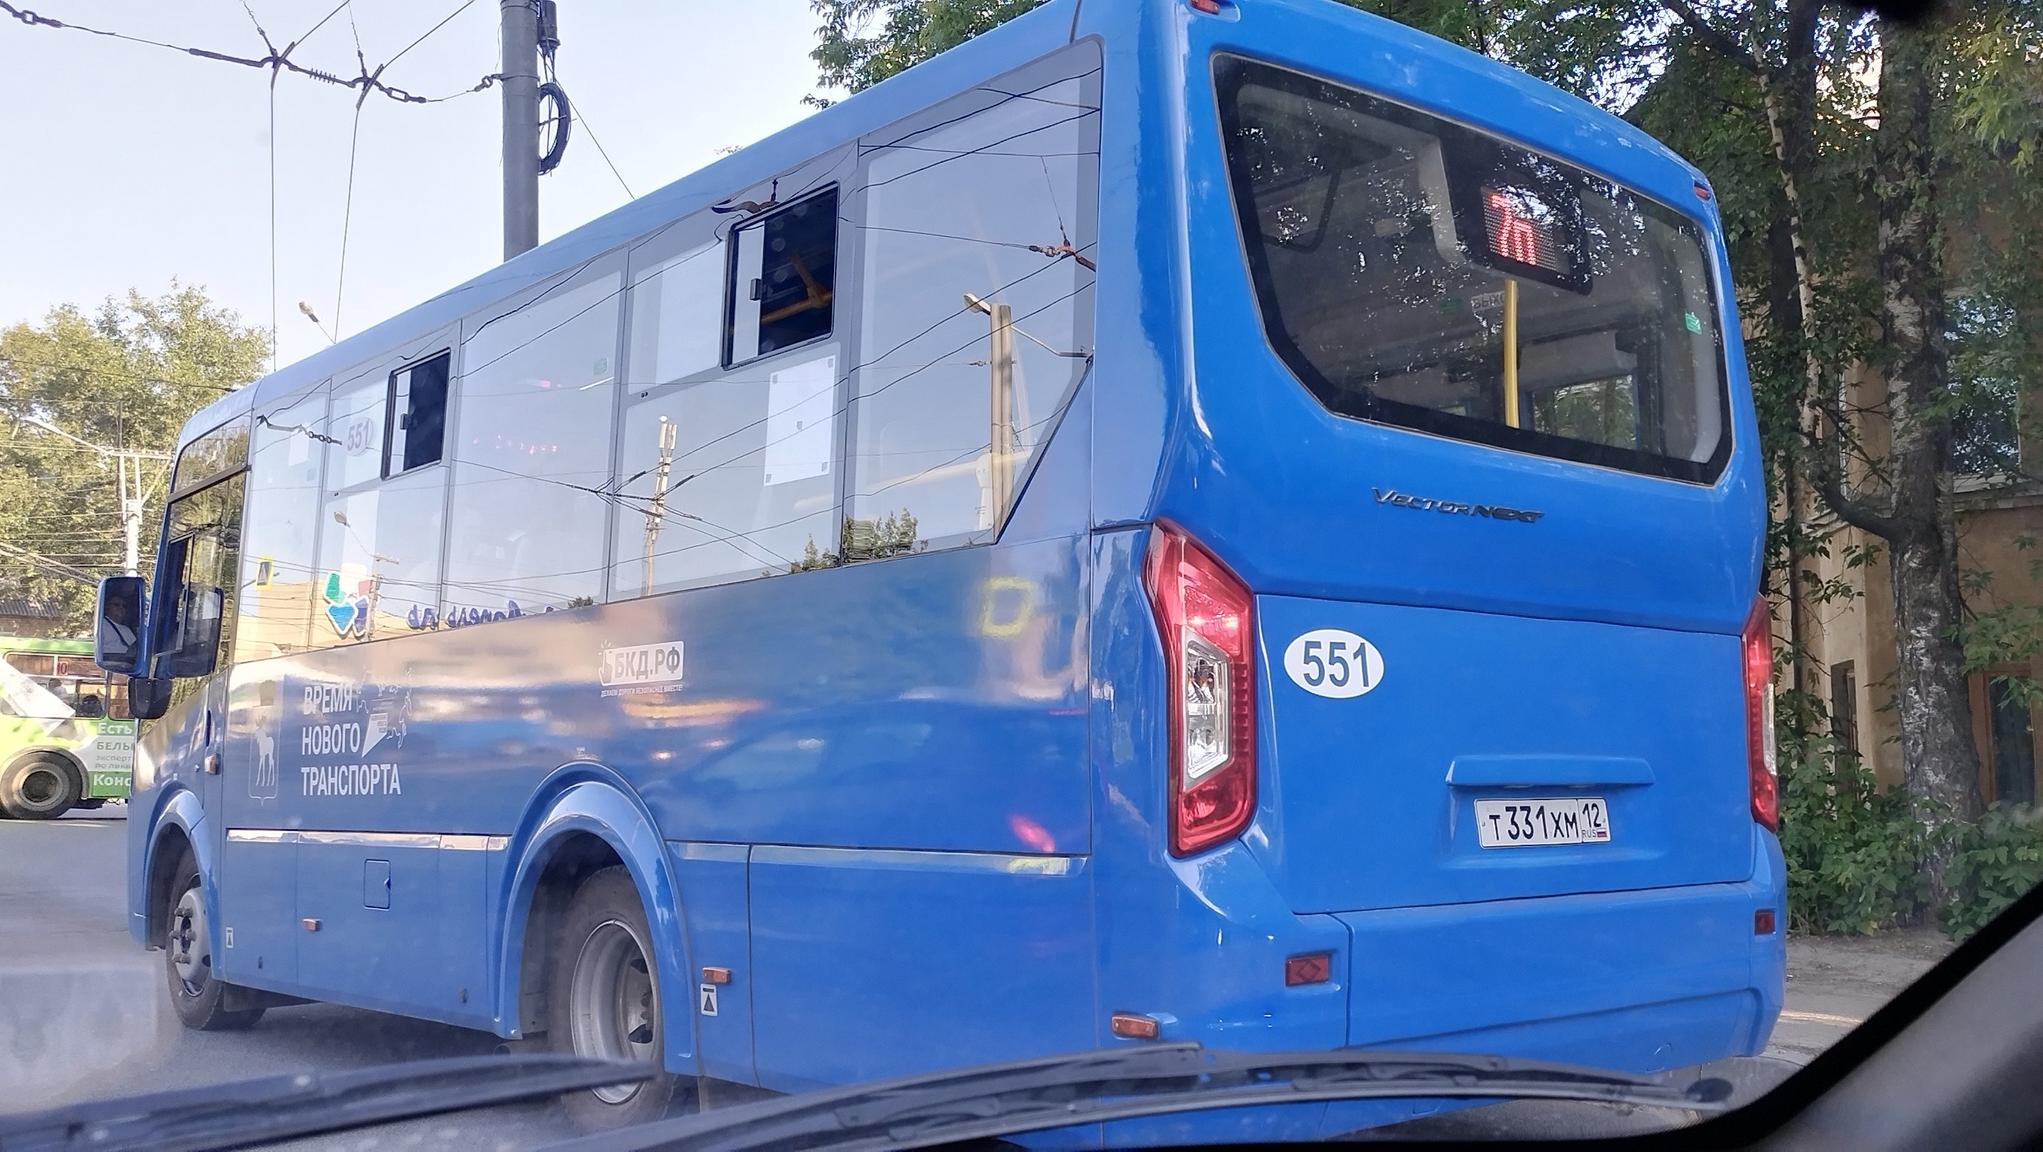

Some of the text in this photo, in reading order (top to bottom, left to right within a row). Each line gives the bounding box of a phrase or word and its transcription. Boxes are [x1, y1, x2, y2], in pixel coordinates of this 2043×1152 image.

[347, 418, 370, 451] 551
[615, 646, 681, 680] БКД.РФ
[1303, 641, 1370, 688] 551
[303, 683, 353, 715] ВРЕМЯ
[98, 722, 133, 735] Есть
[302, 722, 361, 756] НОВОГО
[301, 763, 401, 796] ТРАНСПОРТА
[1582, 803, 1602, 828] 12
[1581, 829, 1597, 838] RUS
